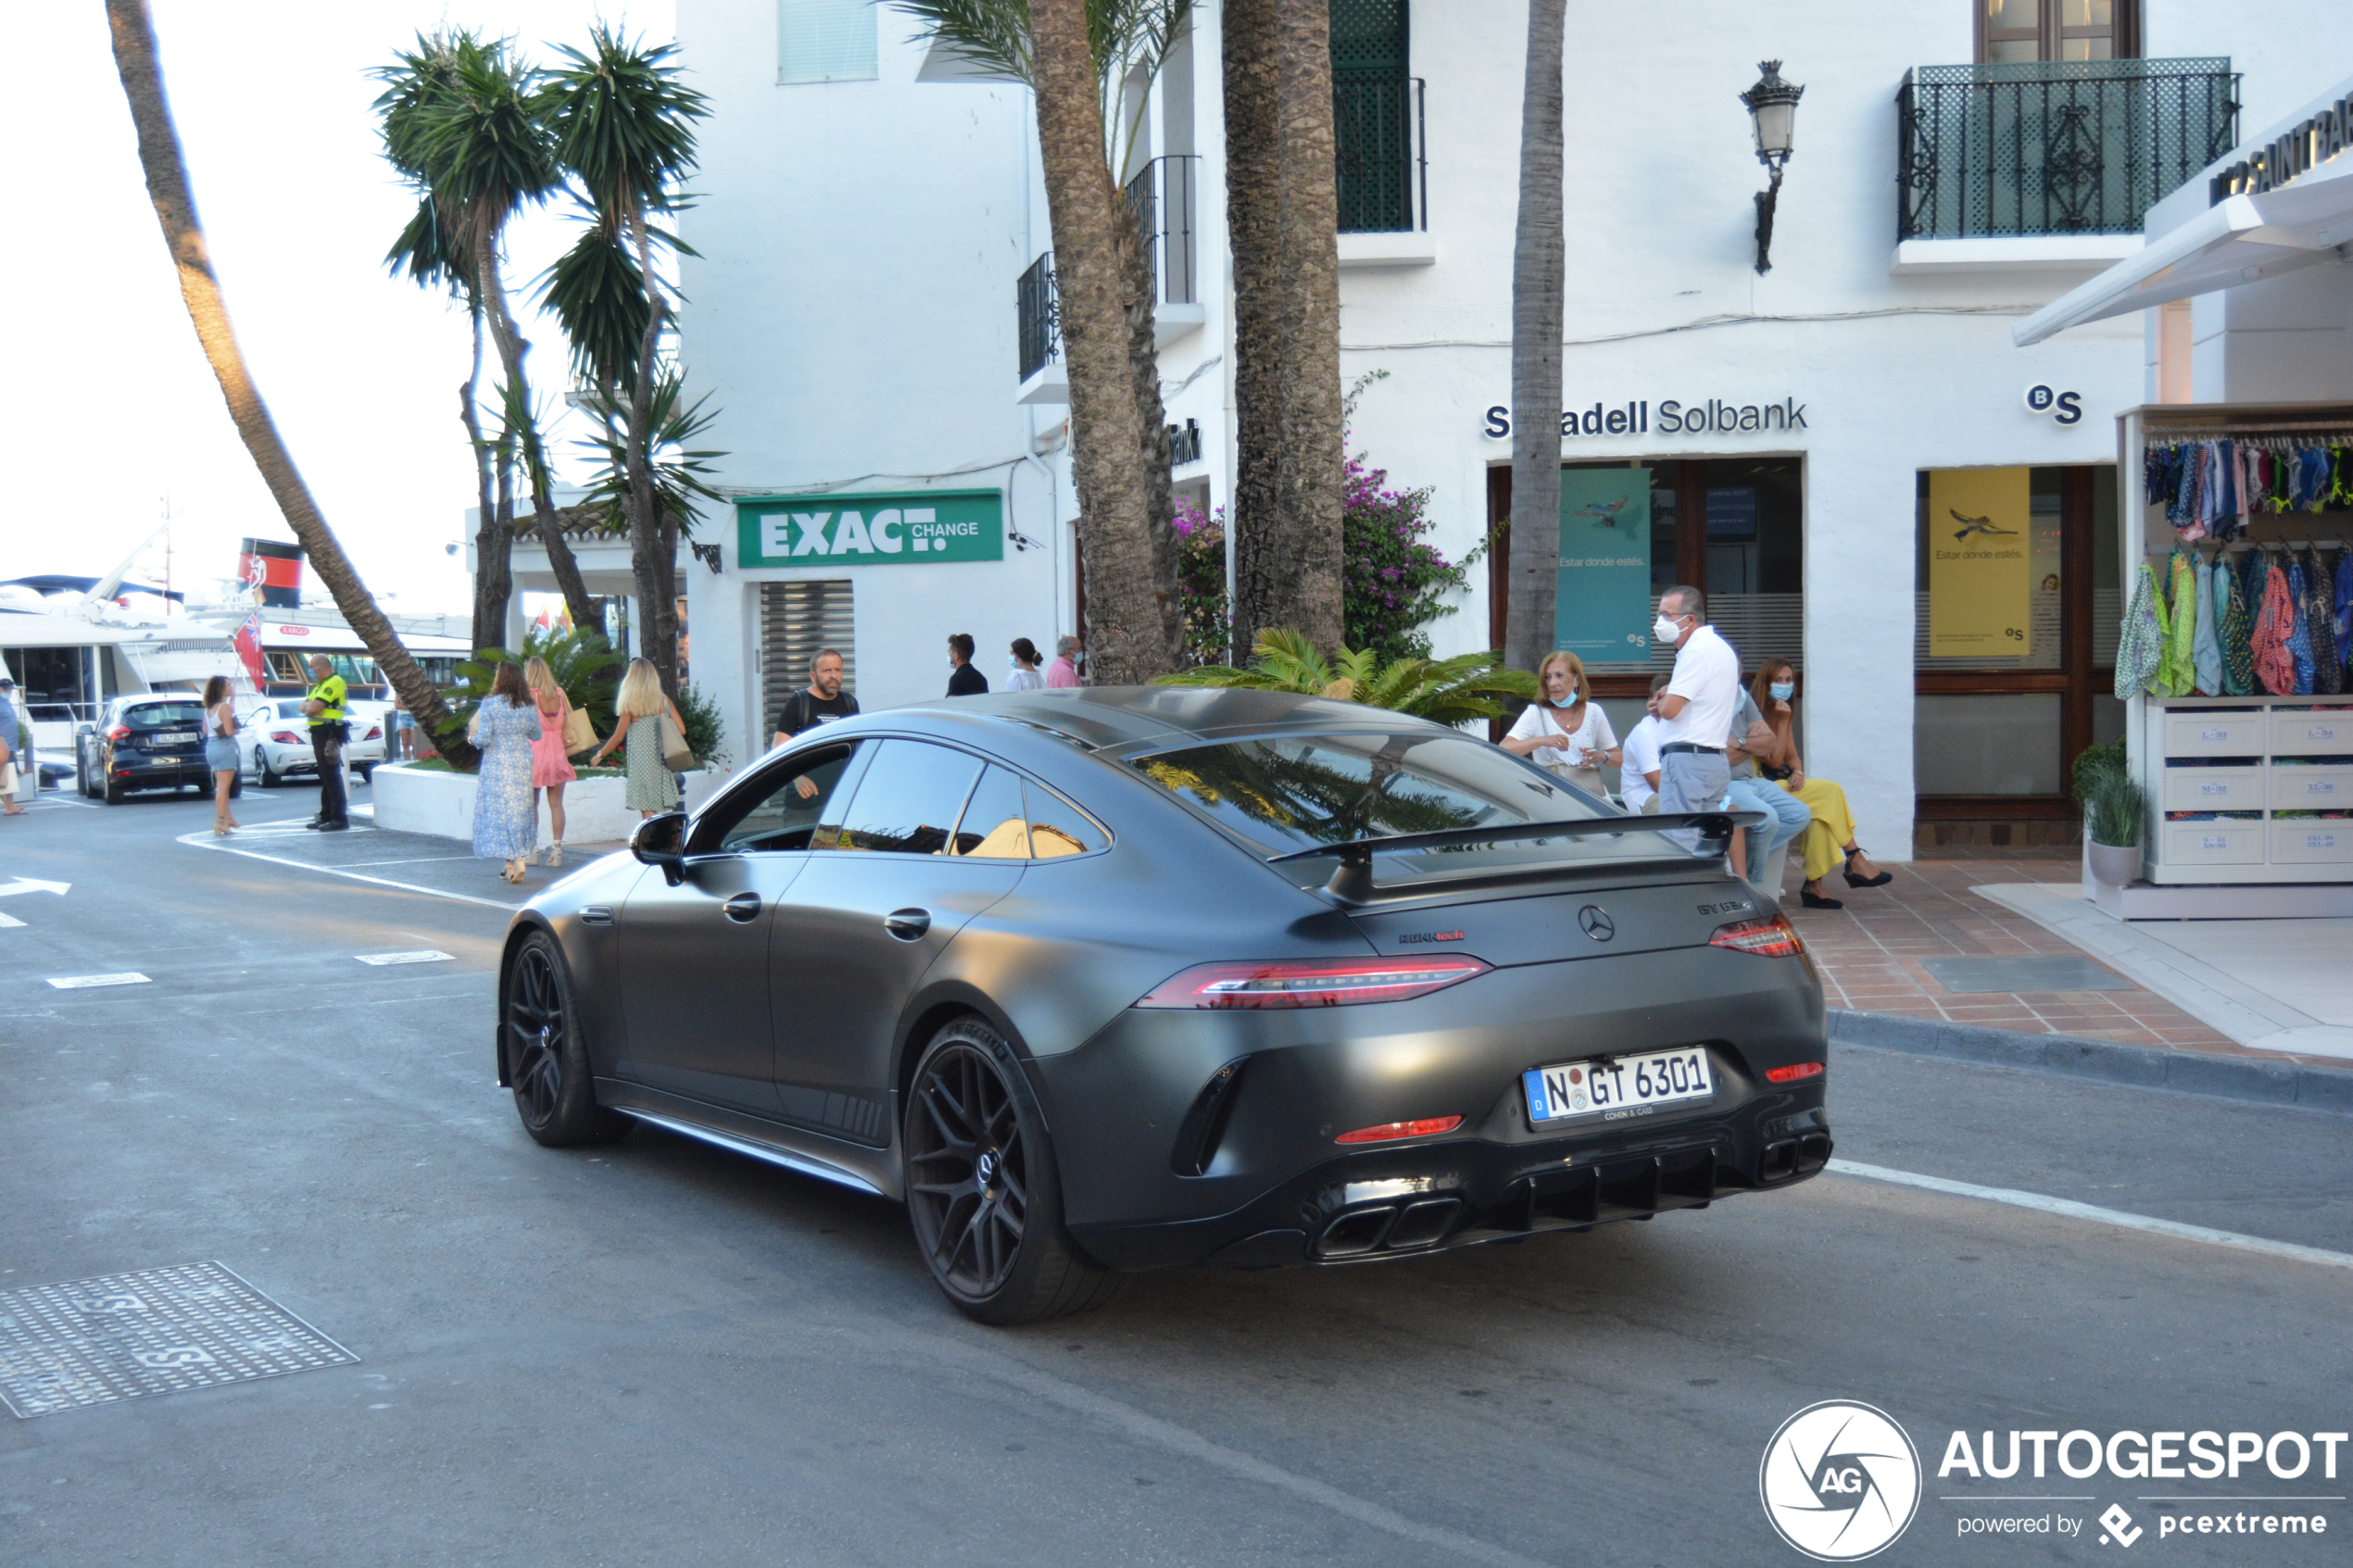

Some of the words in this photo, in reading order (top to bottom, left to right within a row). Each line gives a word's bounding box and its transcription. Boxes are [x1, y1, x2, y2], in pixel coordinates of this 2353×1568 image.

[2248, 119, 2314, 196] SAINT
[1484, 401, 1648, 439] Sadell
[1658, 396, 1808, 434] Solbank
[912, 522, 978, 537] CHANGE
[1936, 551, 1960, 559] Estar
[1963, 550, 1992, 558] donde
[1994, 549, 2023, 558] estés.
[1559, 558, 1583, 567] Estar
[1585, 558, 1614, 566] donde
[1617, 557, 1644, 566] estés.
[1546, 1073, 1570, 1111] N
[1588, 1064, 1625, 1105] GT
[1635, 1054, 1707, 1098] 6301
[1534, 1099, 1543, 1111] D
[1604, 1110, 1628, 1121] COHEN
[1637, 1106, 1654, 1115] CARS
